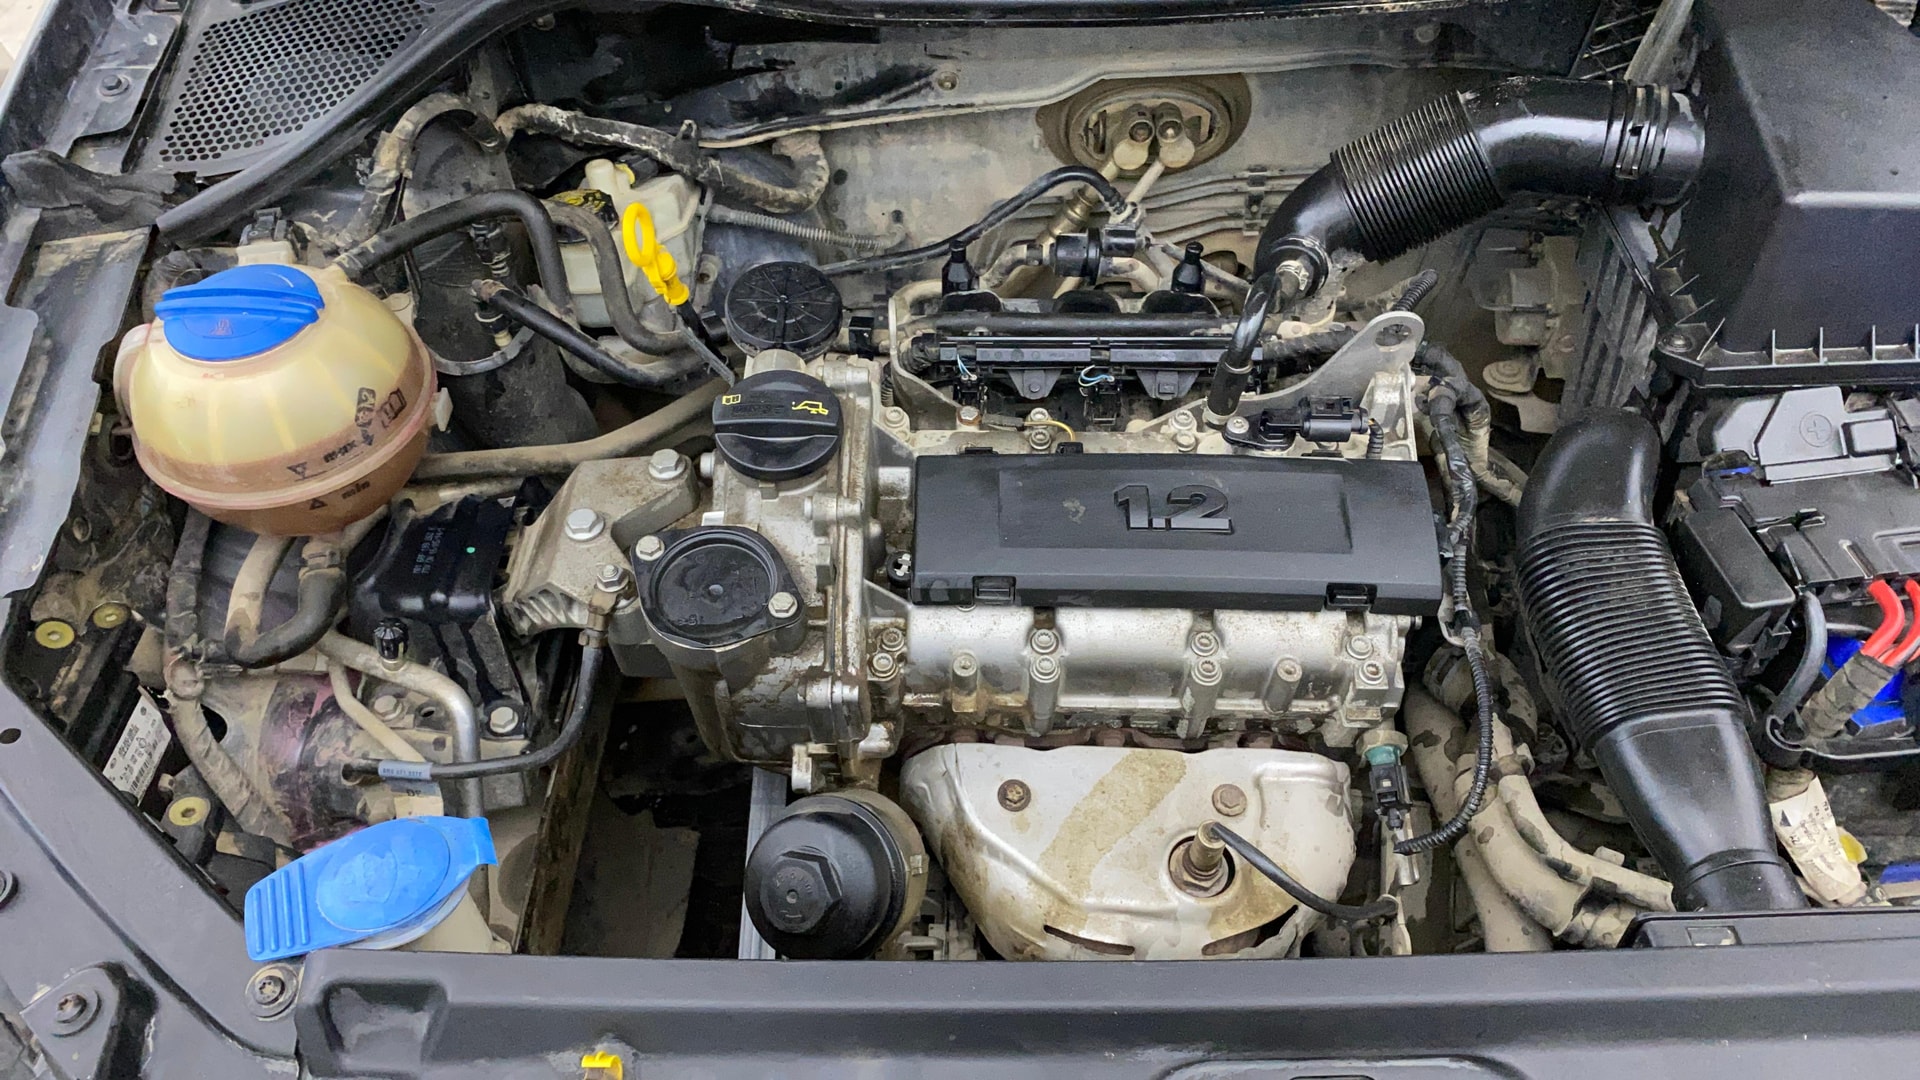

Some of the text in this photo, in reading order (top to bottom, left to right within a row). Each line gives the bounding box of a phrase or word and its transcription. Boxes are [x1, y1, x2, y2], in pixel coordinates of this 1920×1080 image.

[323, 440, 357, 463] max
[341, 481, 370, 499] min
[1114, 484, 1232, 533] 1.2
